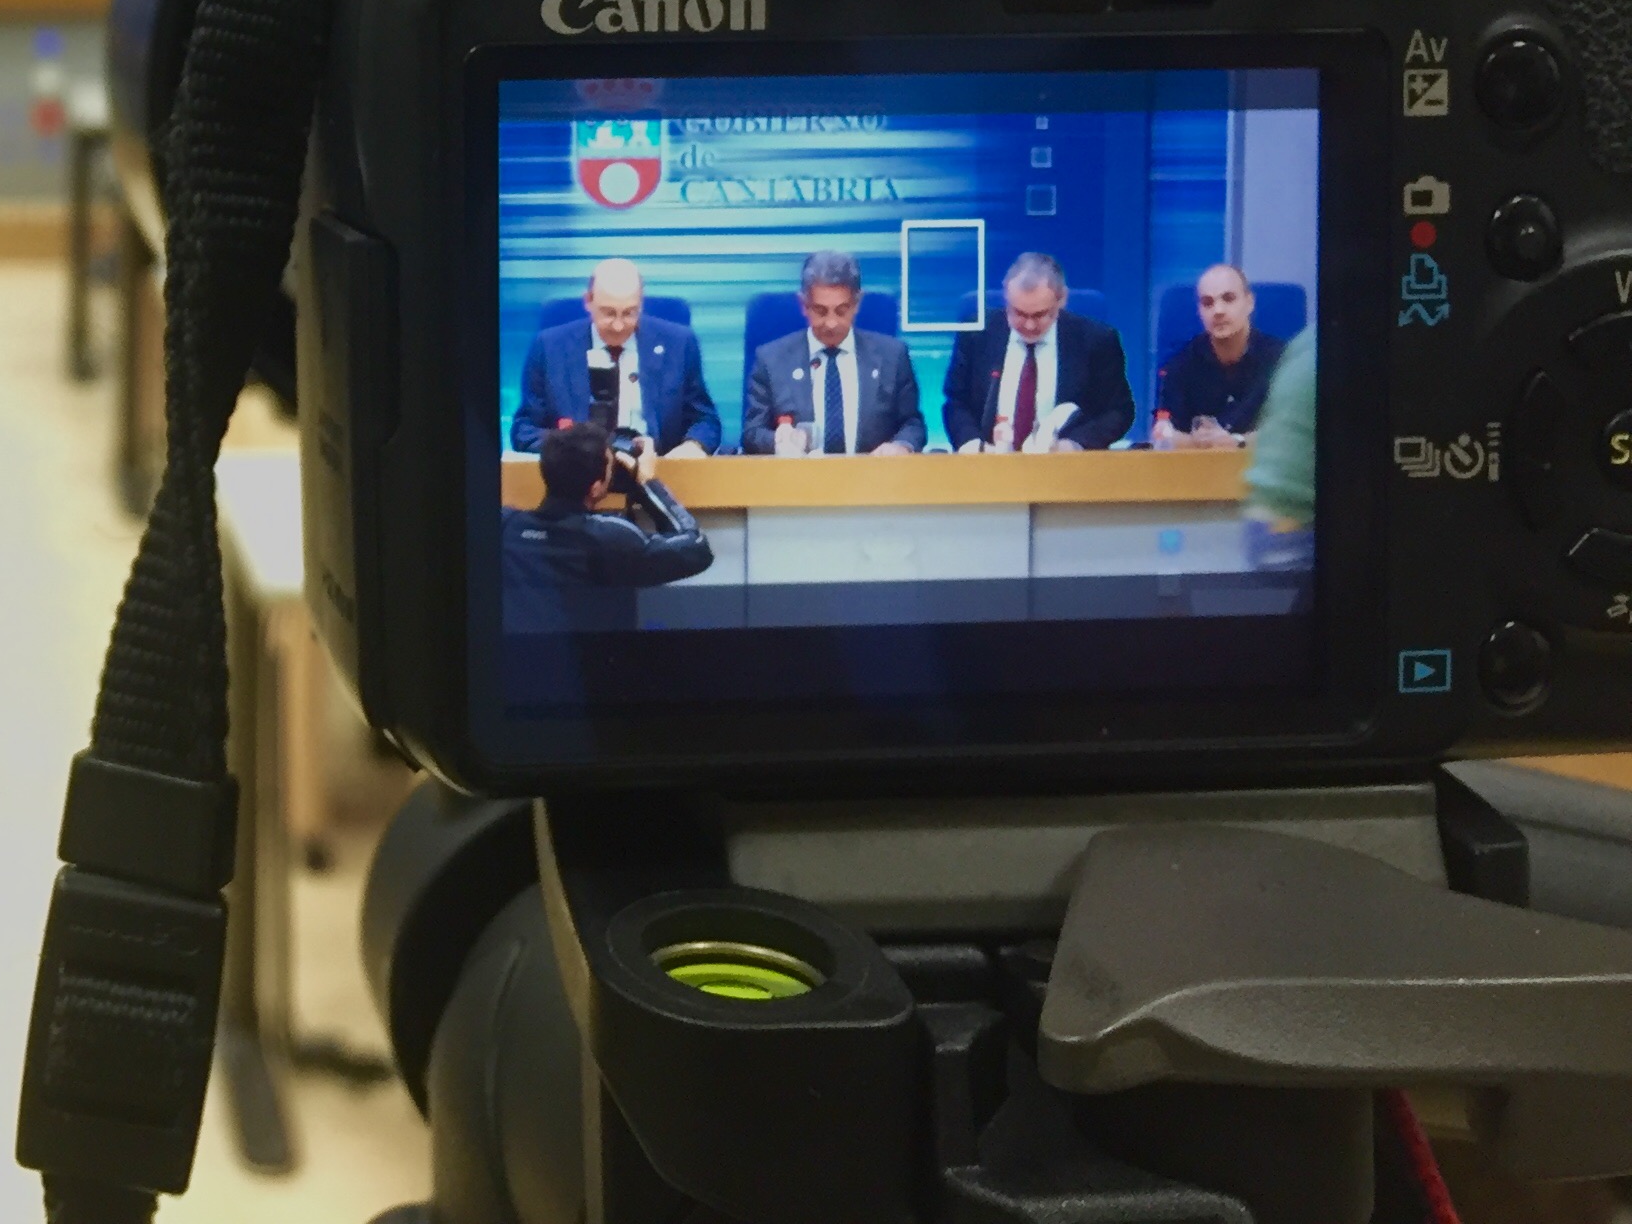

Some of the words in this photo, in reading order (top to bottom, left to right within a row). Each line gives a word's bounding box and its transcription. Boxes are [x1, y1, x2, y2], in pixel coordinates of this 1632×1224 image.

[1404, 29, 1449, 64] Av
[679, 144, 715, 170] de
[679, 176, 900, 203] CANTABRIA
